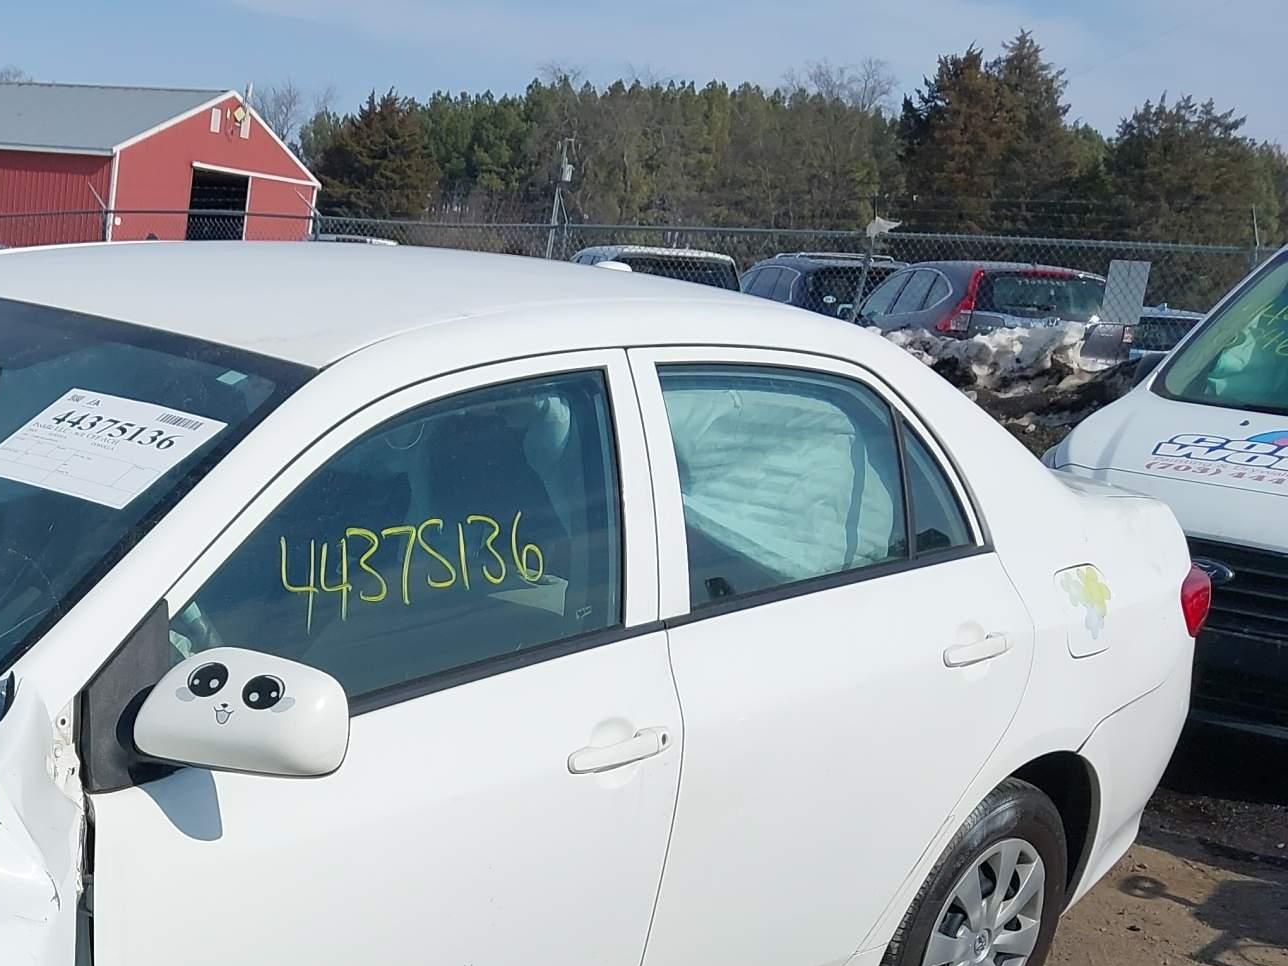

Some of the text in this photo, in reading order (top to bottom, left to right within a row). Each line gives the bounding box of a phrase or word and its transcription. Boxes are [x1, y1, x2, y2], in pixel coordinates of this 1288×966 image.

[52, 410, 184, 450] 44375136
[1145, 461, 1222, 475] (703)
[280, 511, 544, 635] 44375136
